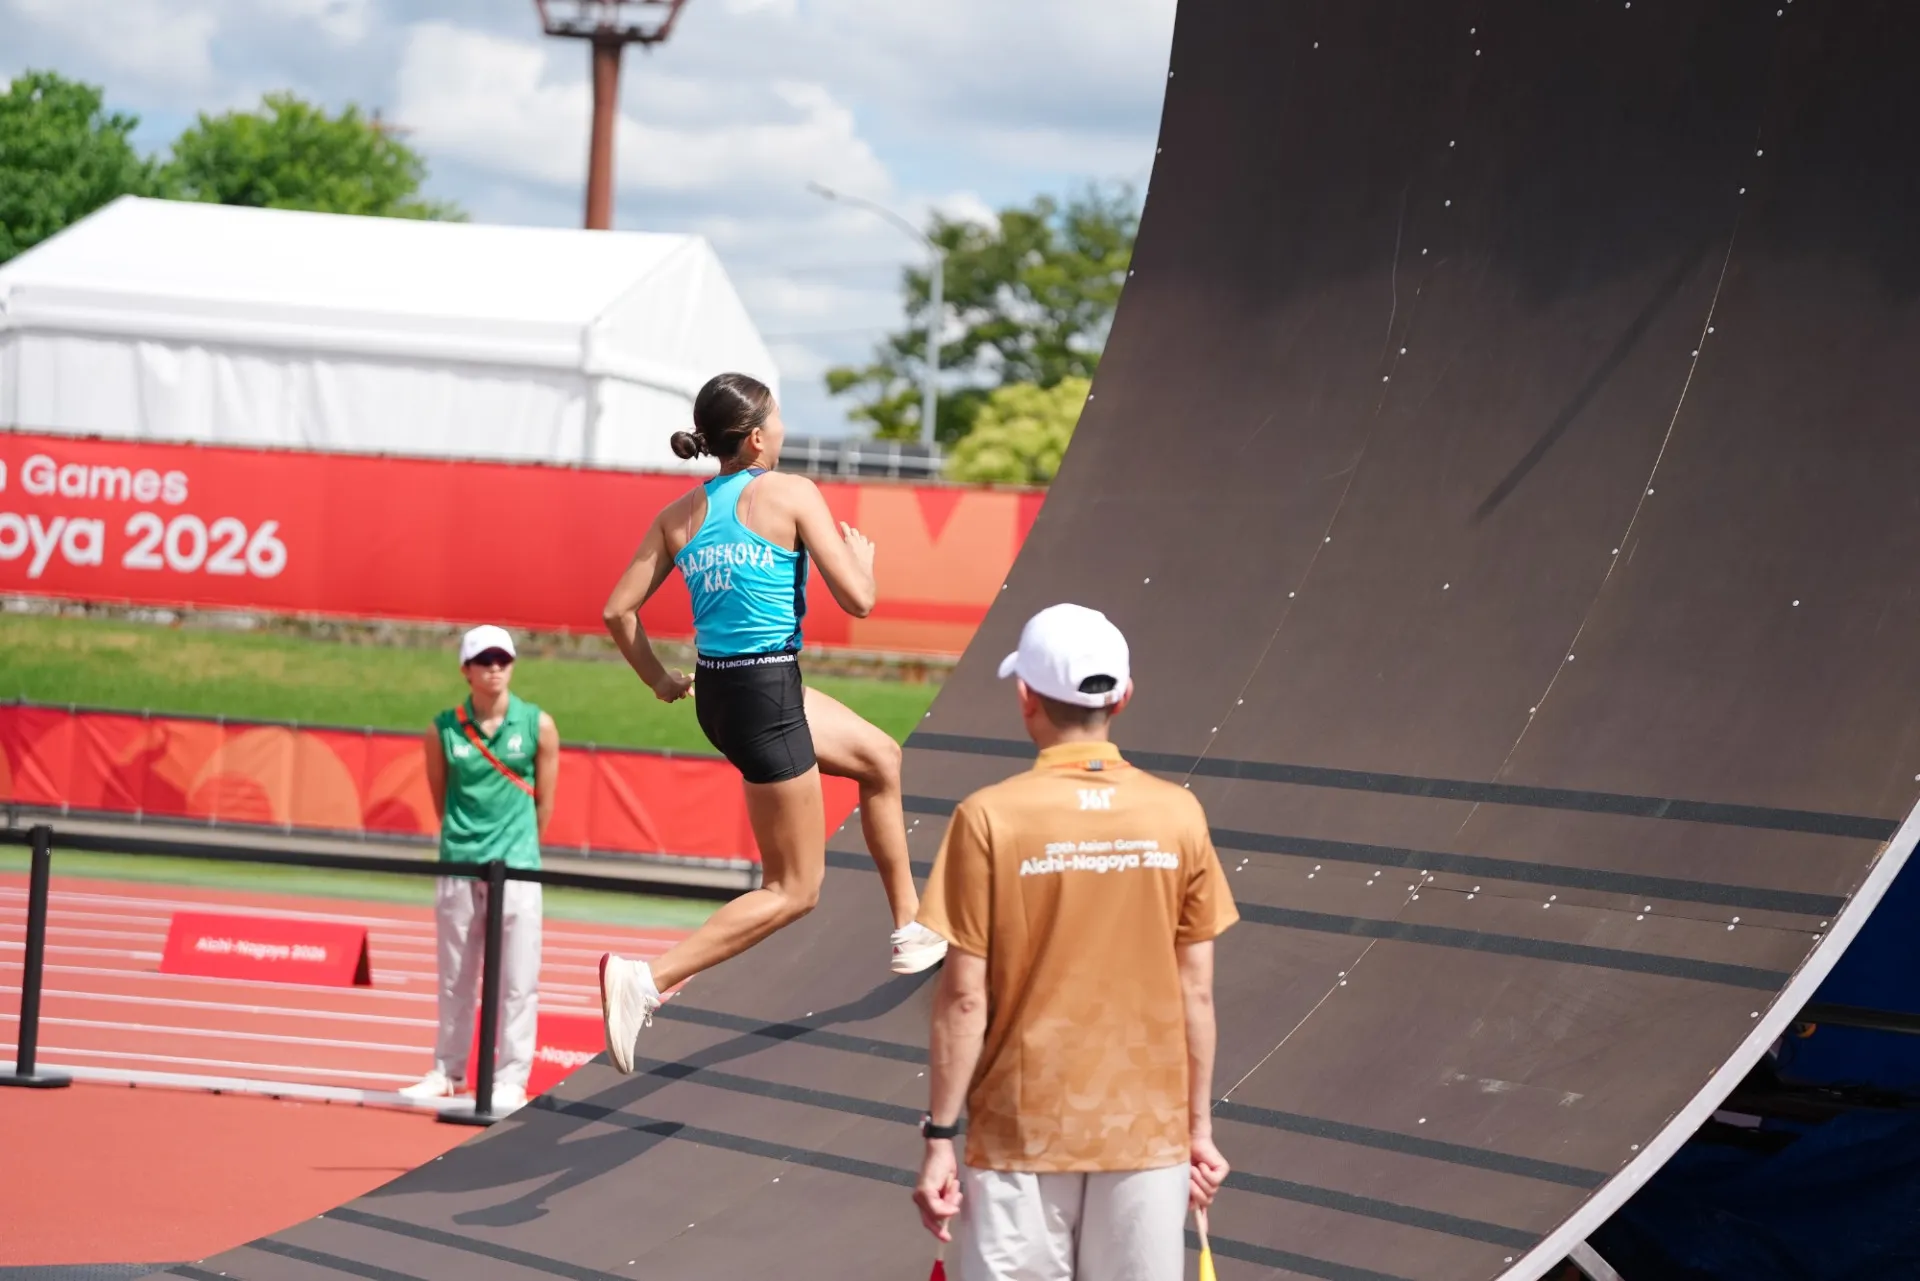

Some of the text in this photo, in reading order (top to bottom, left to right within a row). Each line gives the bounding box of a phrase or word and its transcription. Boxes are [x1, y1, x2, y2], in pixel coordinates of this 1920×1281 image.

[20, 453, 189, 505] Games
[121, 510, 288, 579] 2026
[704, 567, 734, 593] KAZ
[725, 658, 755, 668] UNDER
[1077, 840, 1112, 853] Asian
[1114, 839, 1159, 851] Games
[1019, 851, 1180, 876] Aichi-Nagoya 2026
[194, 936, 290, 962] Aichi-Nagoya
